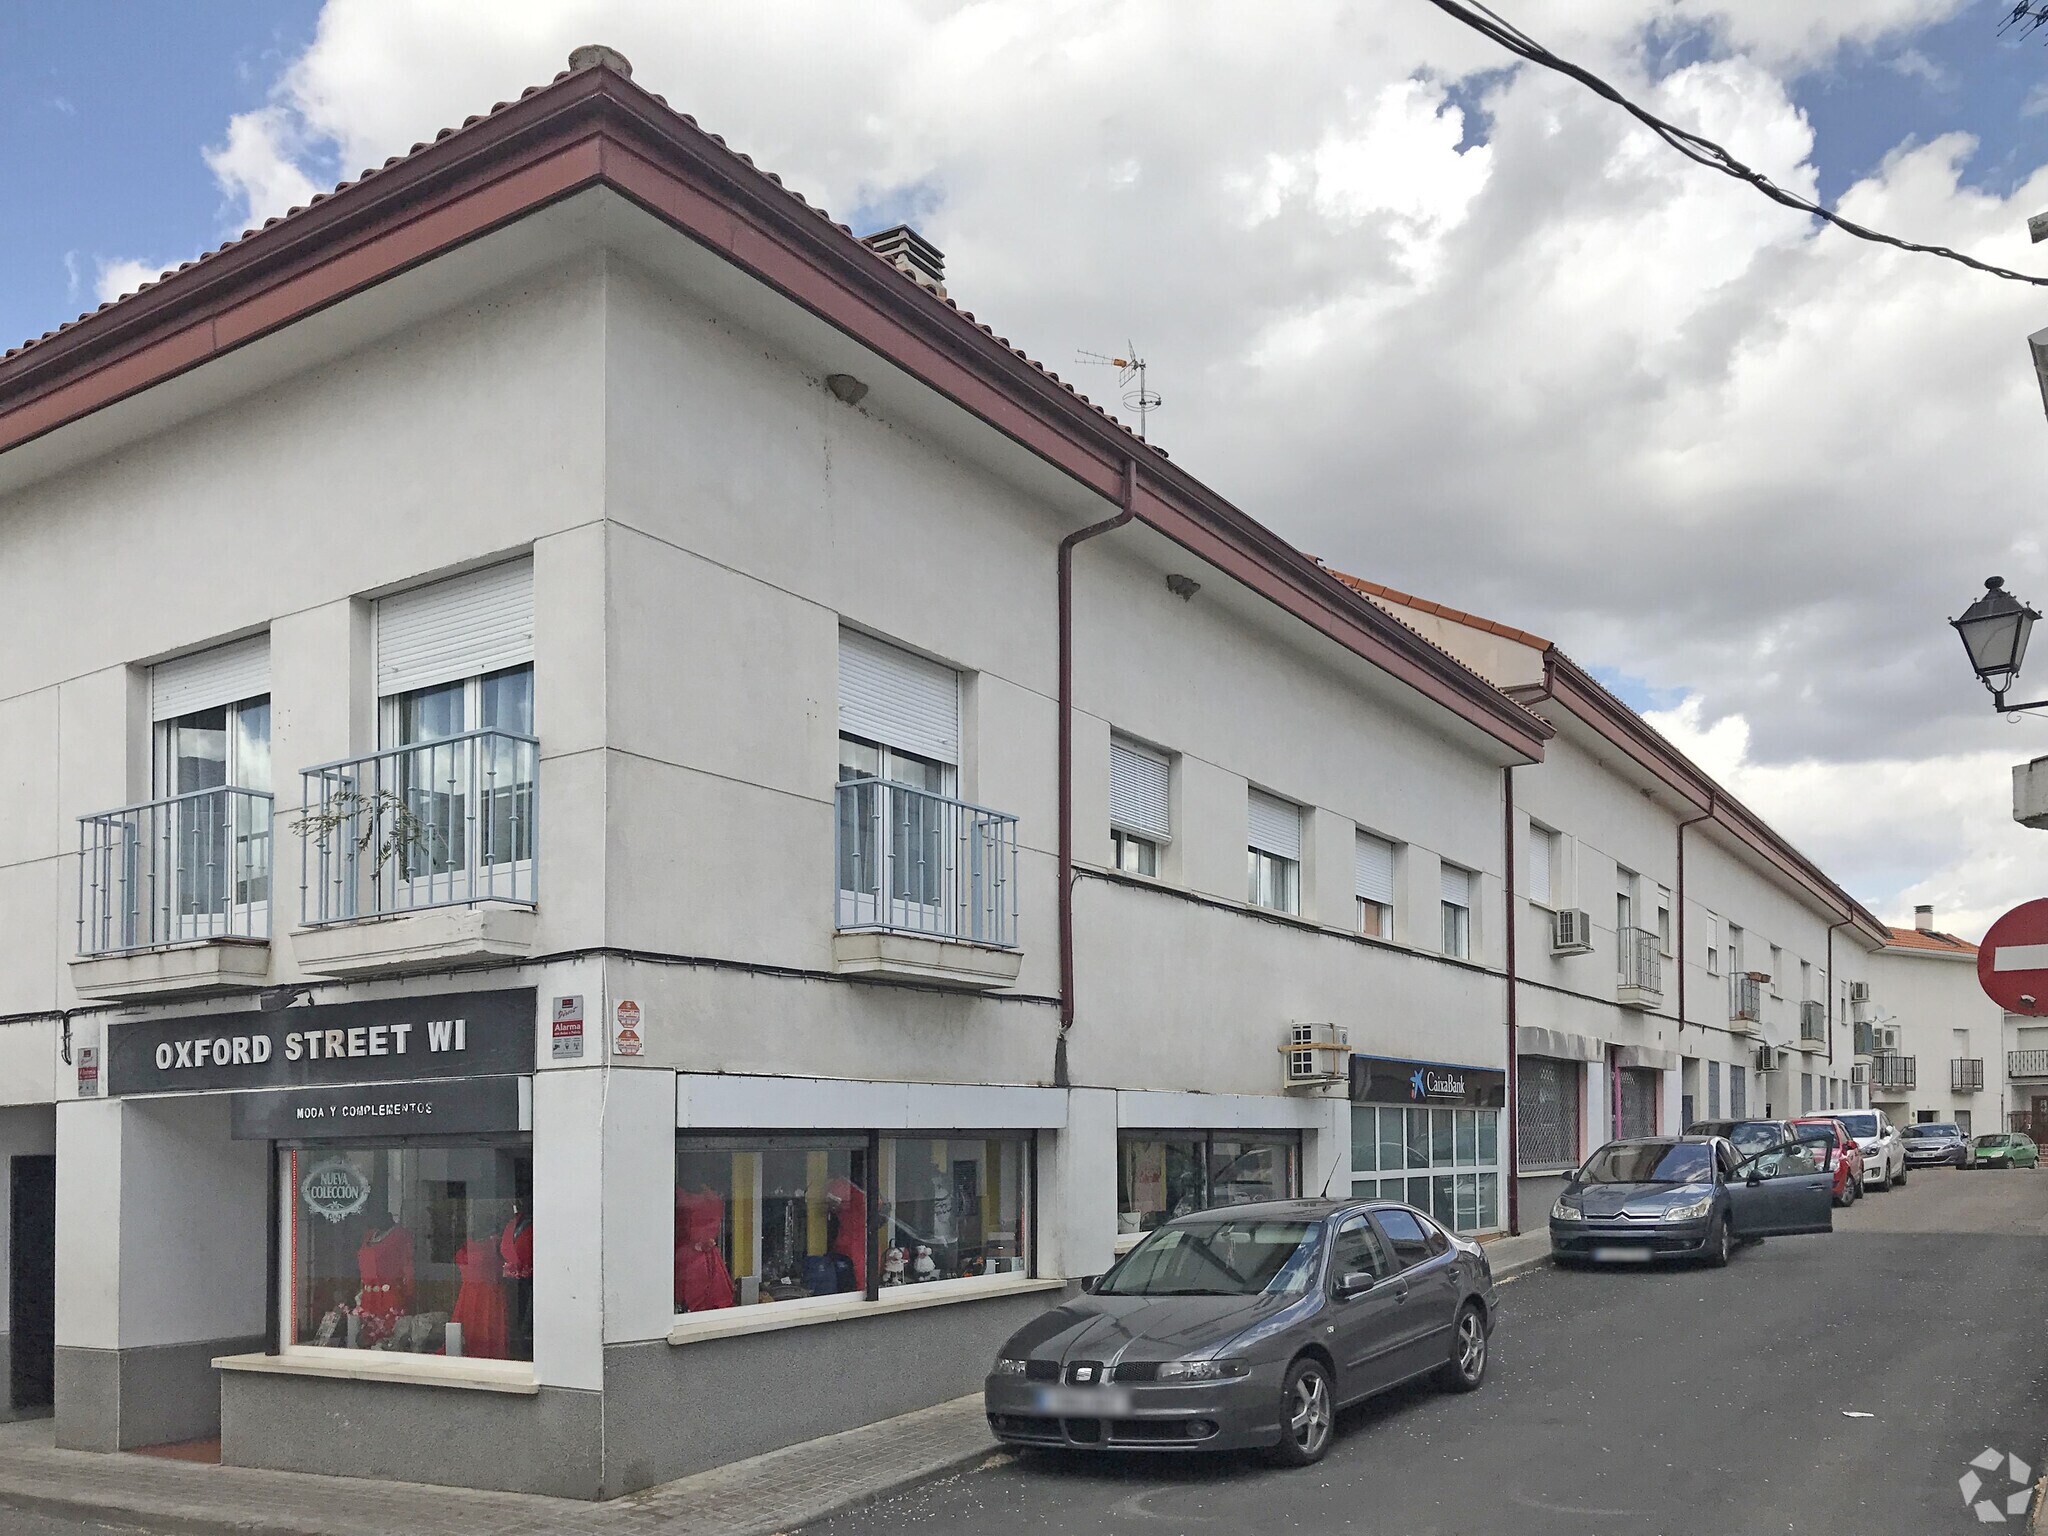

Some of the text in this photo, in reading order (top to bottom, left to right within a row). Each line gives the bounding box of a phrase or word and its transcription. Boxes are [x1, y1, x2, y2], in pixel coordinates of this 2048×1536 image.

[554, 1023, 581, 1031] Alarma
[155, 1035, 273, 1070] OXFORD
[284, 1024, 413, 1061] STREET
[1427, 1070, 1466, 1094] CaixaBank
[296, 1102, 433, 1119] MODA Y COMPLEMENTOS
[321, 1172, 349, 1185] NUEVA
[312, 1184, 359, 1199] COLECCIÓN
